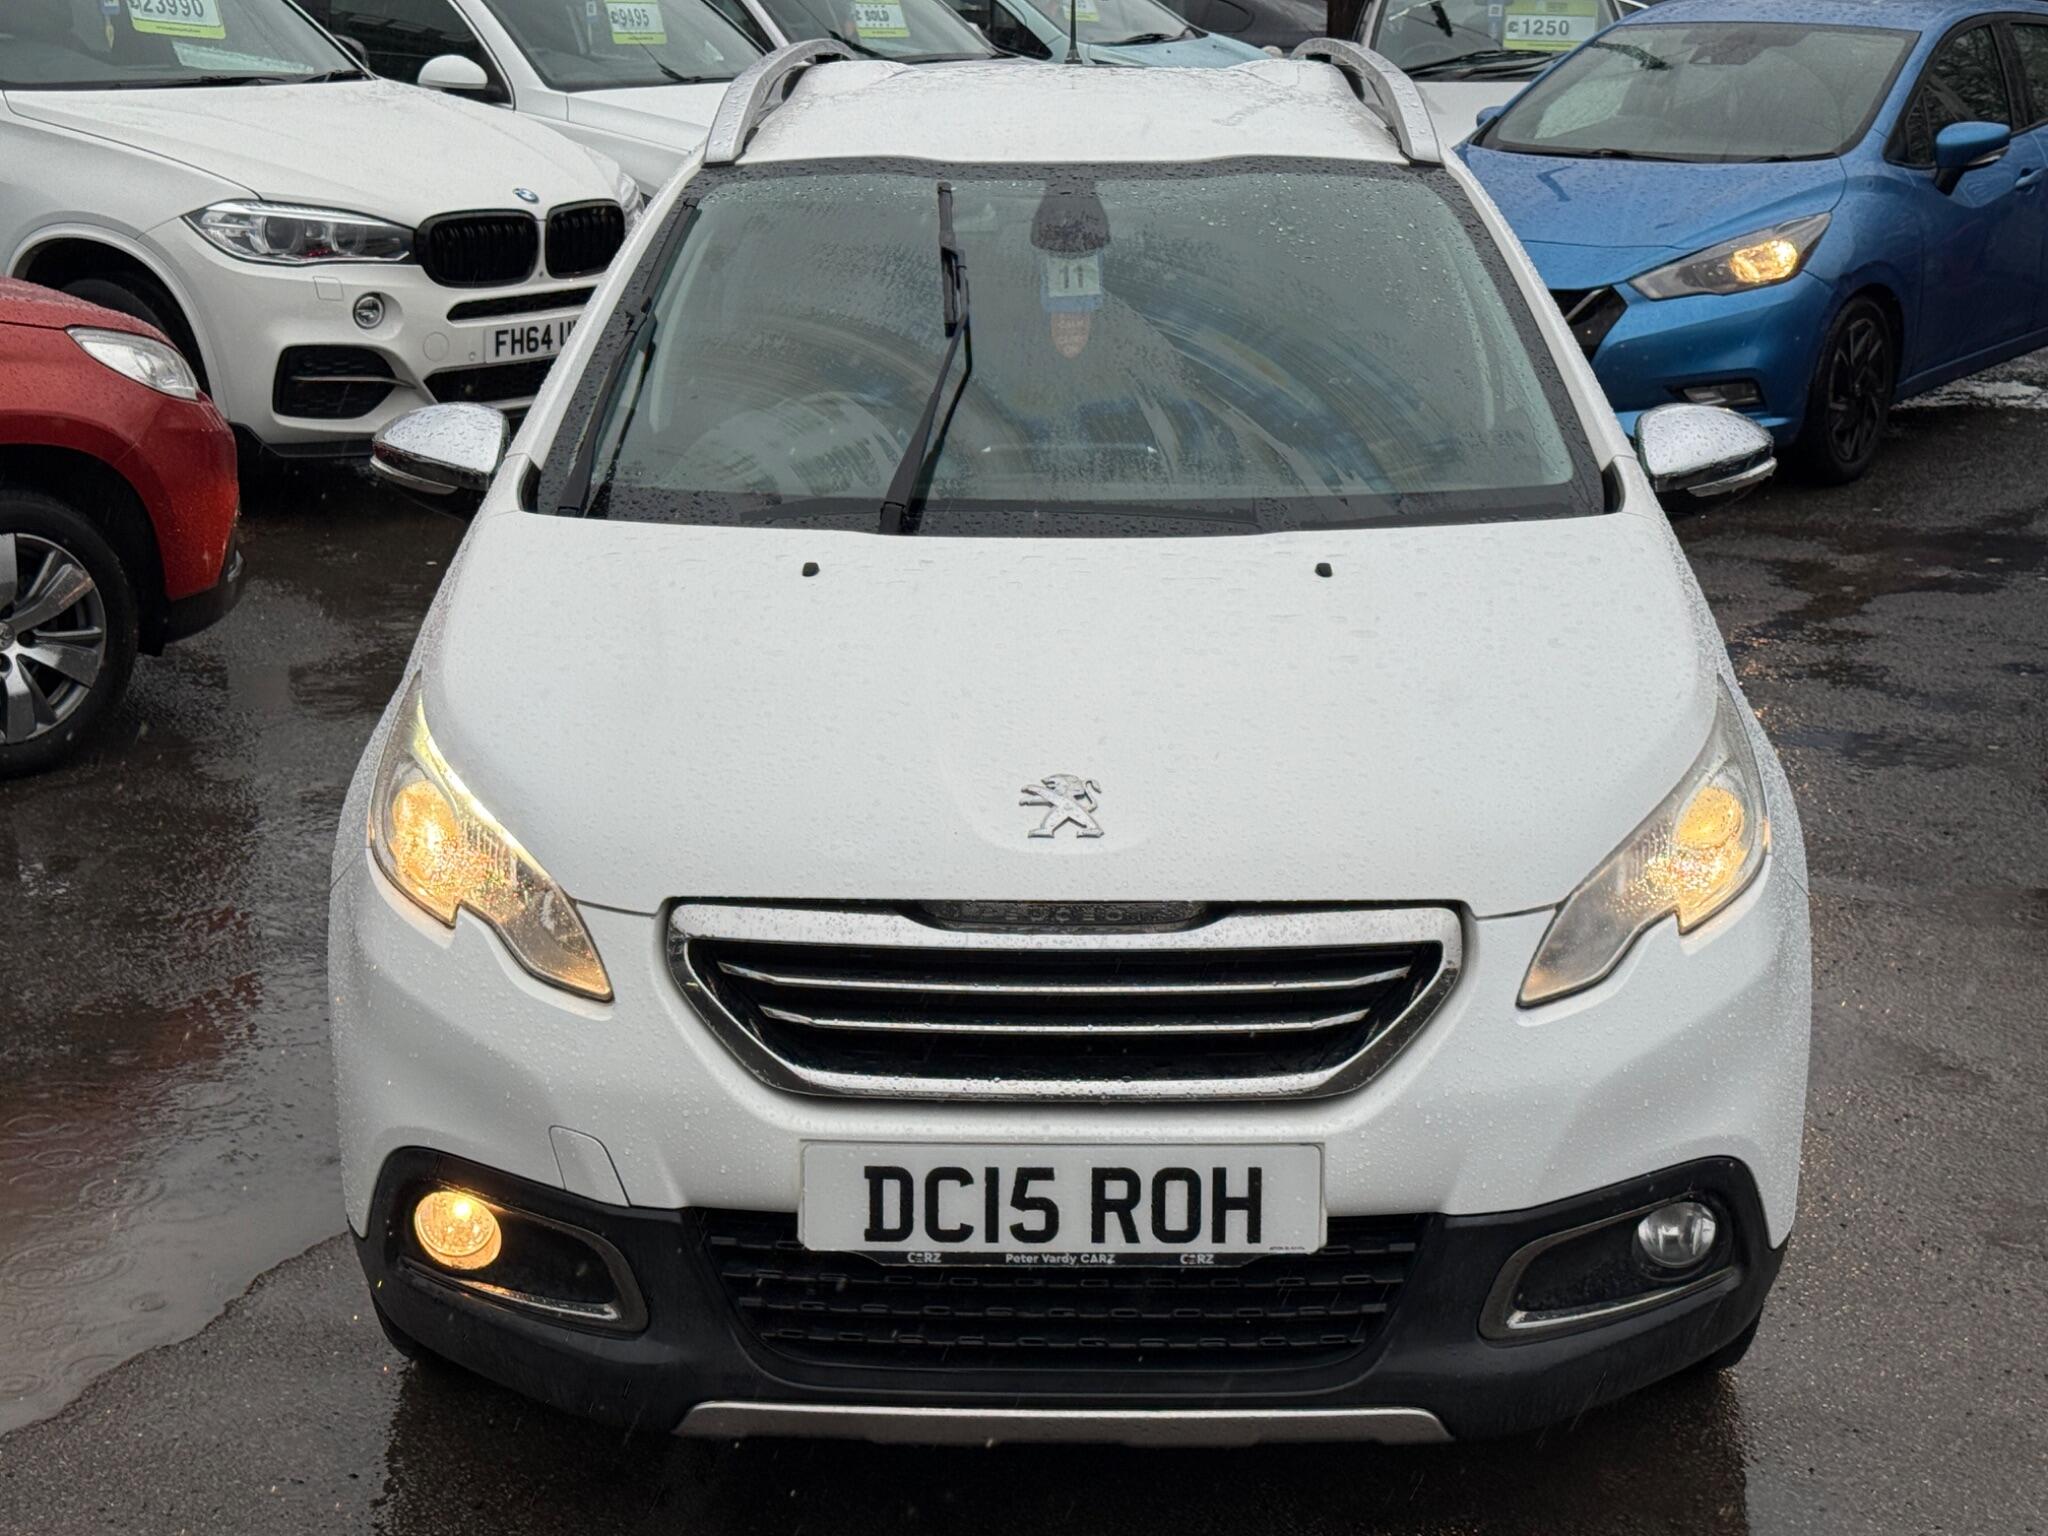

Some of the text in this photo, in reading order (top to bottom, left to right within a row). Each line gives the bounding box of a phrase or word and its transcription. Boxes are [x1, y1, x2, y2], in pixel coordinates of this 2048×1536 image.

[1507, 19, 1569, 36] £1250
[495, 324, 553, 357] FH64
[864, 1165, 1263, 1244] DC15 ROH
[1005, 1252, 1116, 1266] Peter Vardy CARZ
